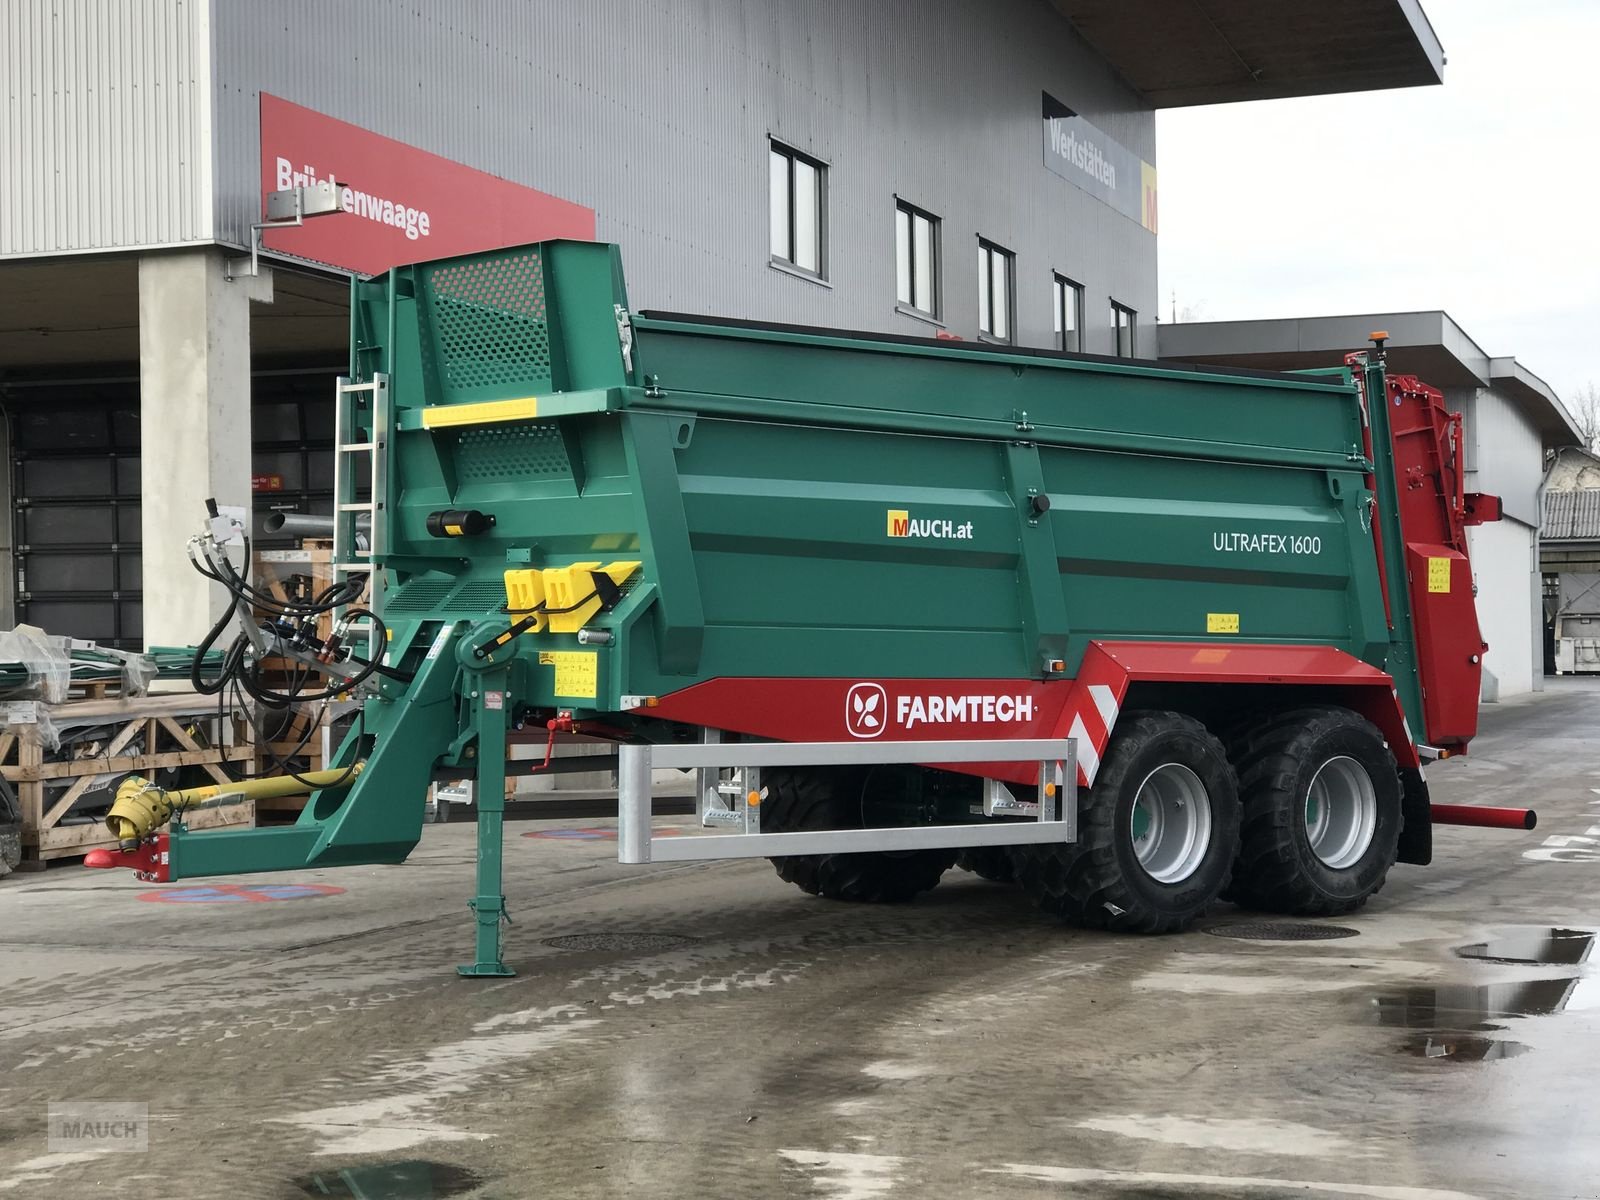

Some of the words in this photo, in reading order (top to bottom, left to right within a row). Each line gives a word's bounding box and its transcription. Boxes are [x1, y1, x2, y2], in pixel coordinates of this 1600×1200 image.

[1049, 115, 1116, 189] Werkstätten
[276, 157, 430, 240] Brüenwaage
[893, 518, 973, 539] MAUCH.at
[1213, 532, 1287, 554] ULTRAFEX
[1290, 535, 1321, 555] 1600
[896, 695, 1032, 729] FARMTECH
